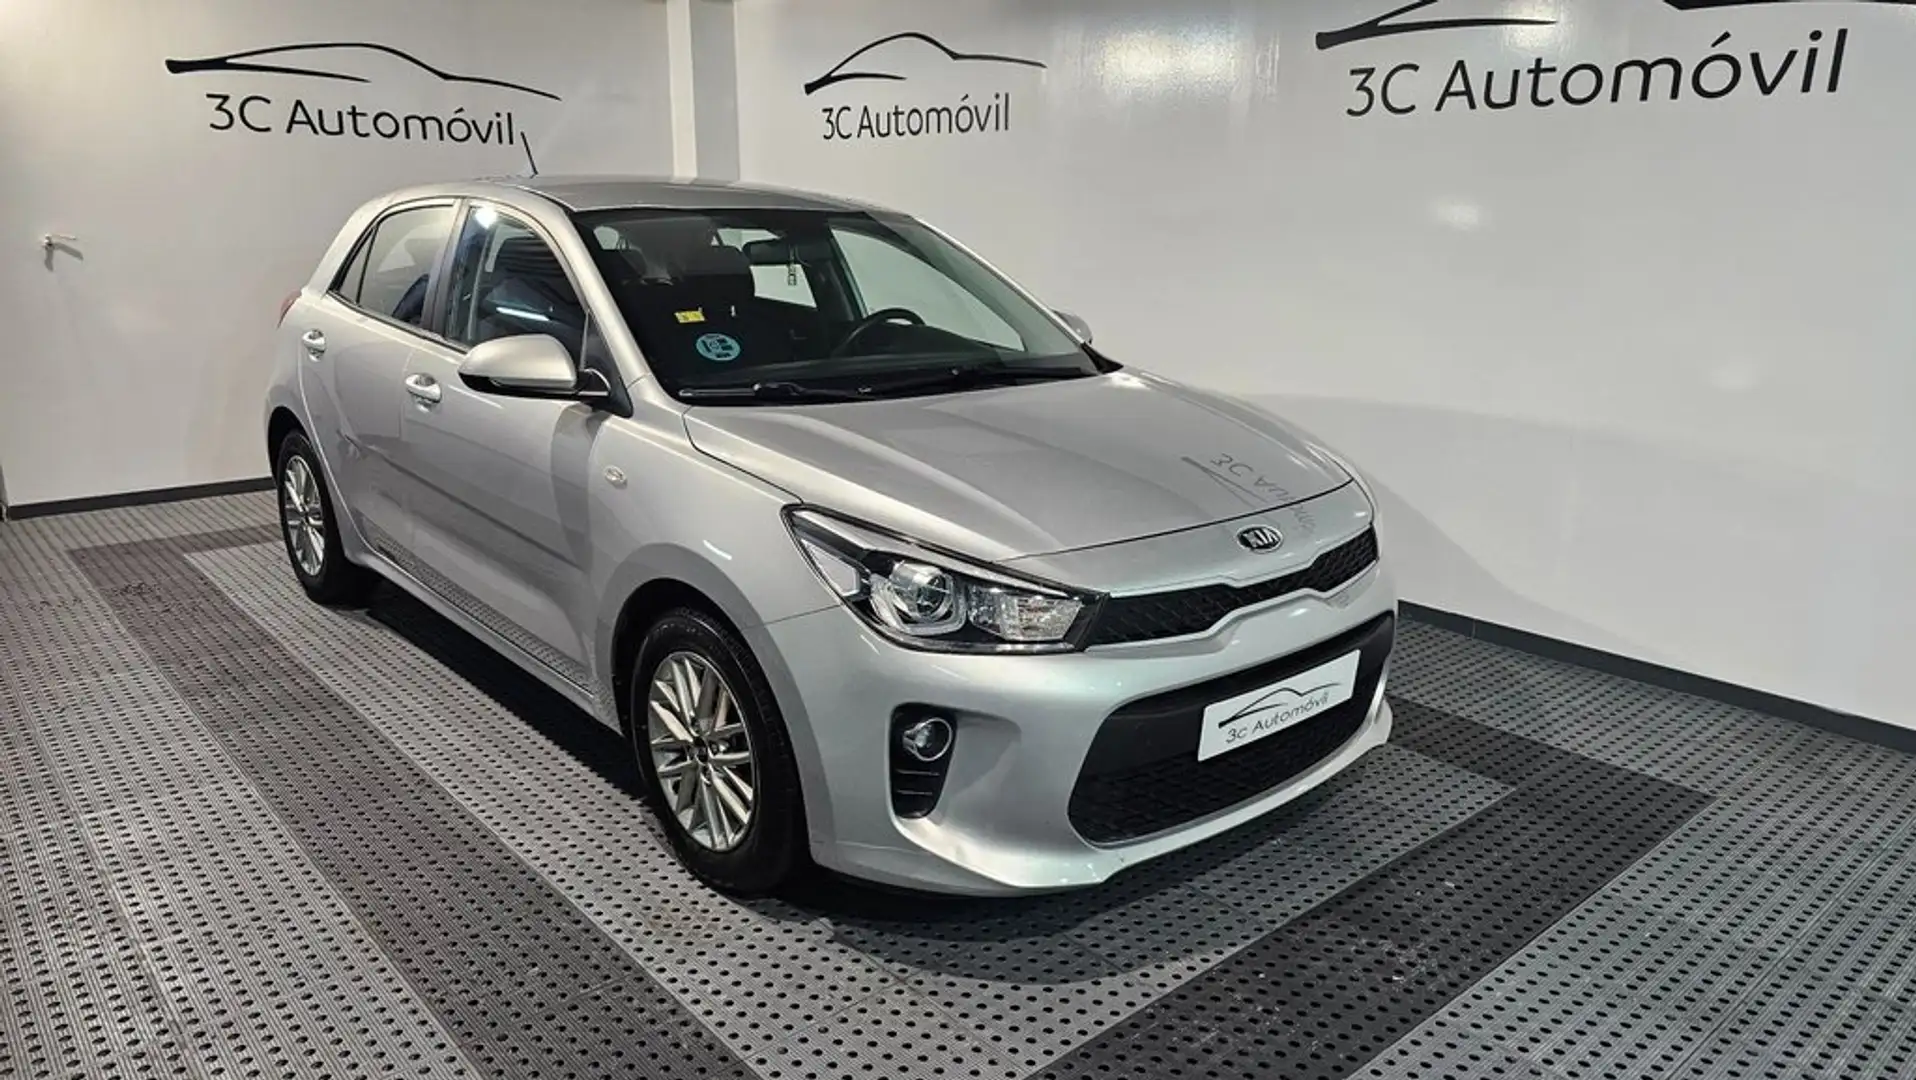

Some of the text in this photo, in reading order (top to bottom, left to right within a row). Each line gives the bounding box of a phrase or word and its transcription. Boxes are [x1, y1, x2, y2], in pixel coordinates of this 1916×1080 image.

[1346, 28, 1848, 117] 3C Automóvil
[205, 93, 514, 146] 3C Automóvil
[821, 92, 1010, 140] 3C Automóvil
